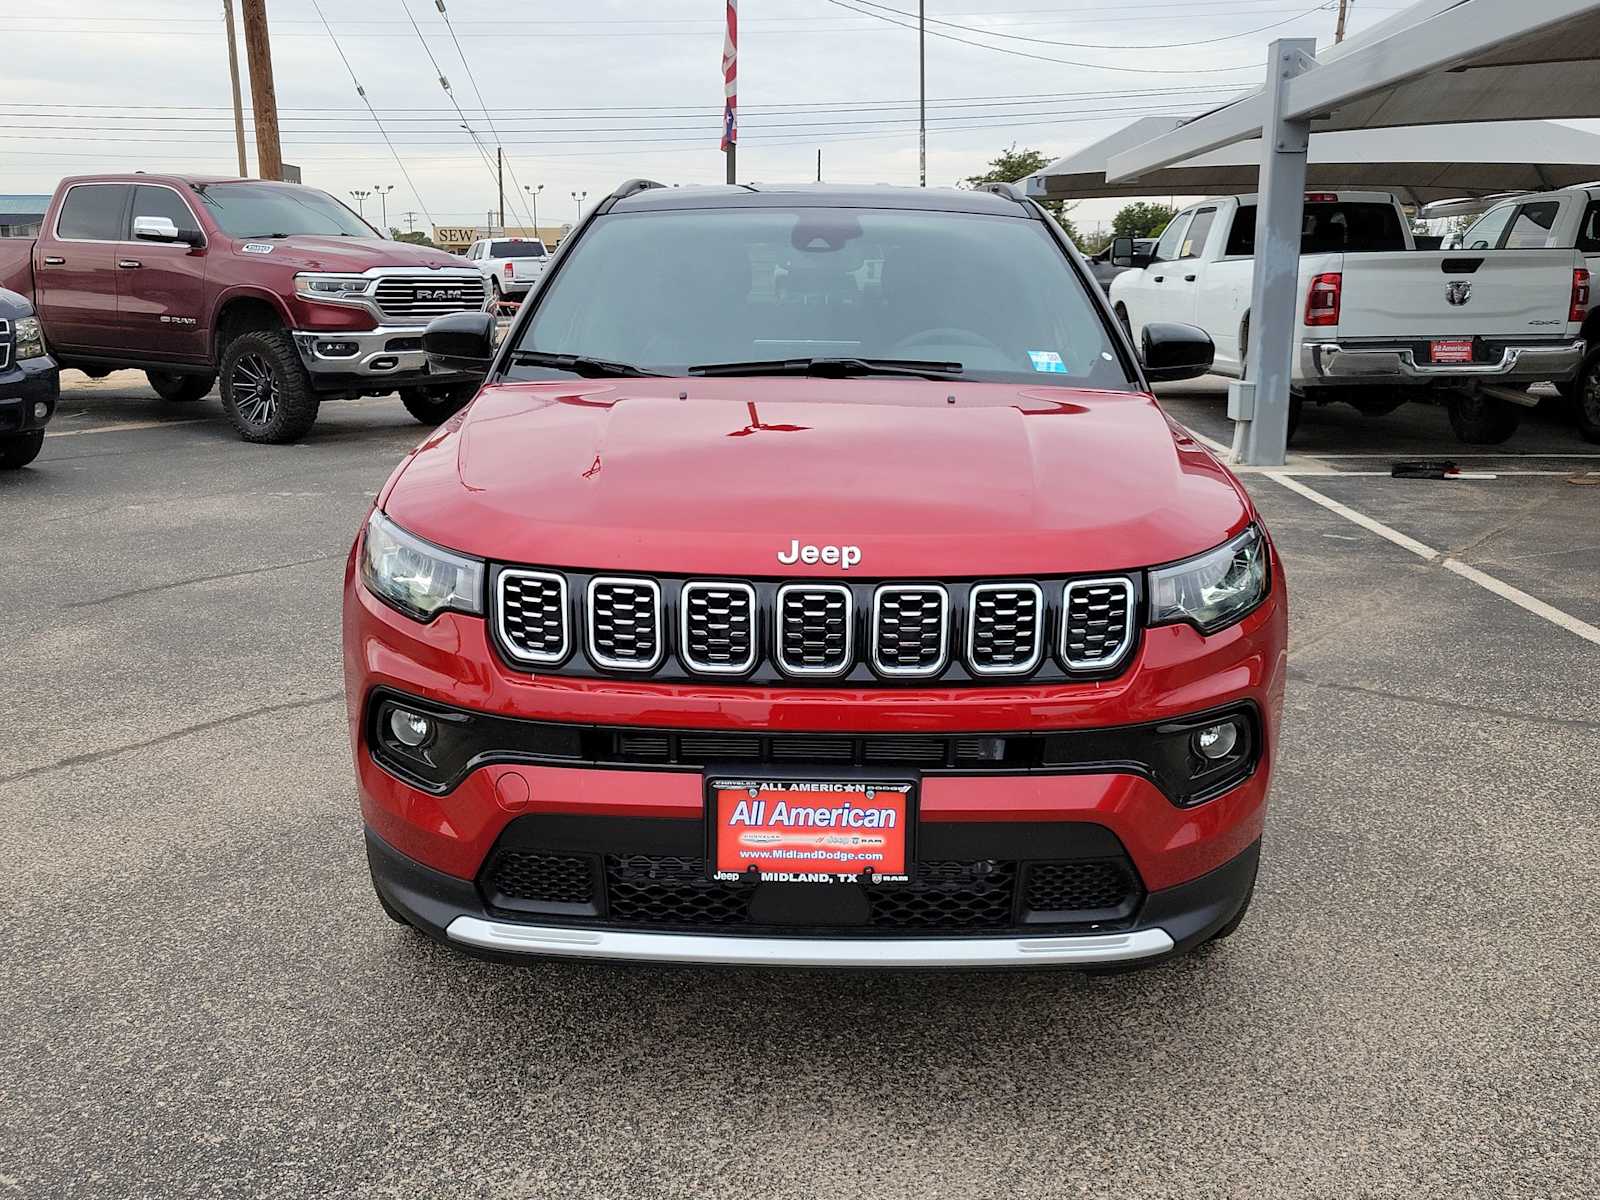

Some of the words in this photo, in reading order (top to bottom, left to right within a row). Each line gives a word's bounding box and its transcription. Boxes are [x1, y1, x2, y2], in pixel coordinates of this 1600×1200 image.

[439, 229, 473, 242] SEW
[416, 290, 461, 299] RAM
[171, 316, 197, 325] RAM
[777, 539, 862, 570] Jeep
[760, 783, 786, 791] ALL
[729, 800, 766, 826] All
[767, 800, 896, 828] American
[740, 850, 883, 861] www.MidlandDodge.com
[713, 871, 739, 881] Jeep
[761, 873, 834, 884] MIDLAND,
[837, 874, 858, 883] TX
